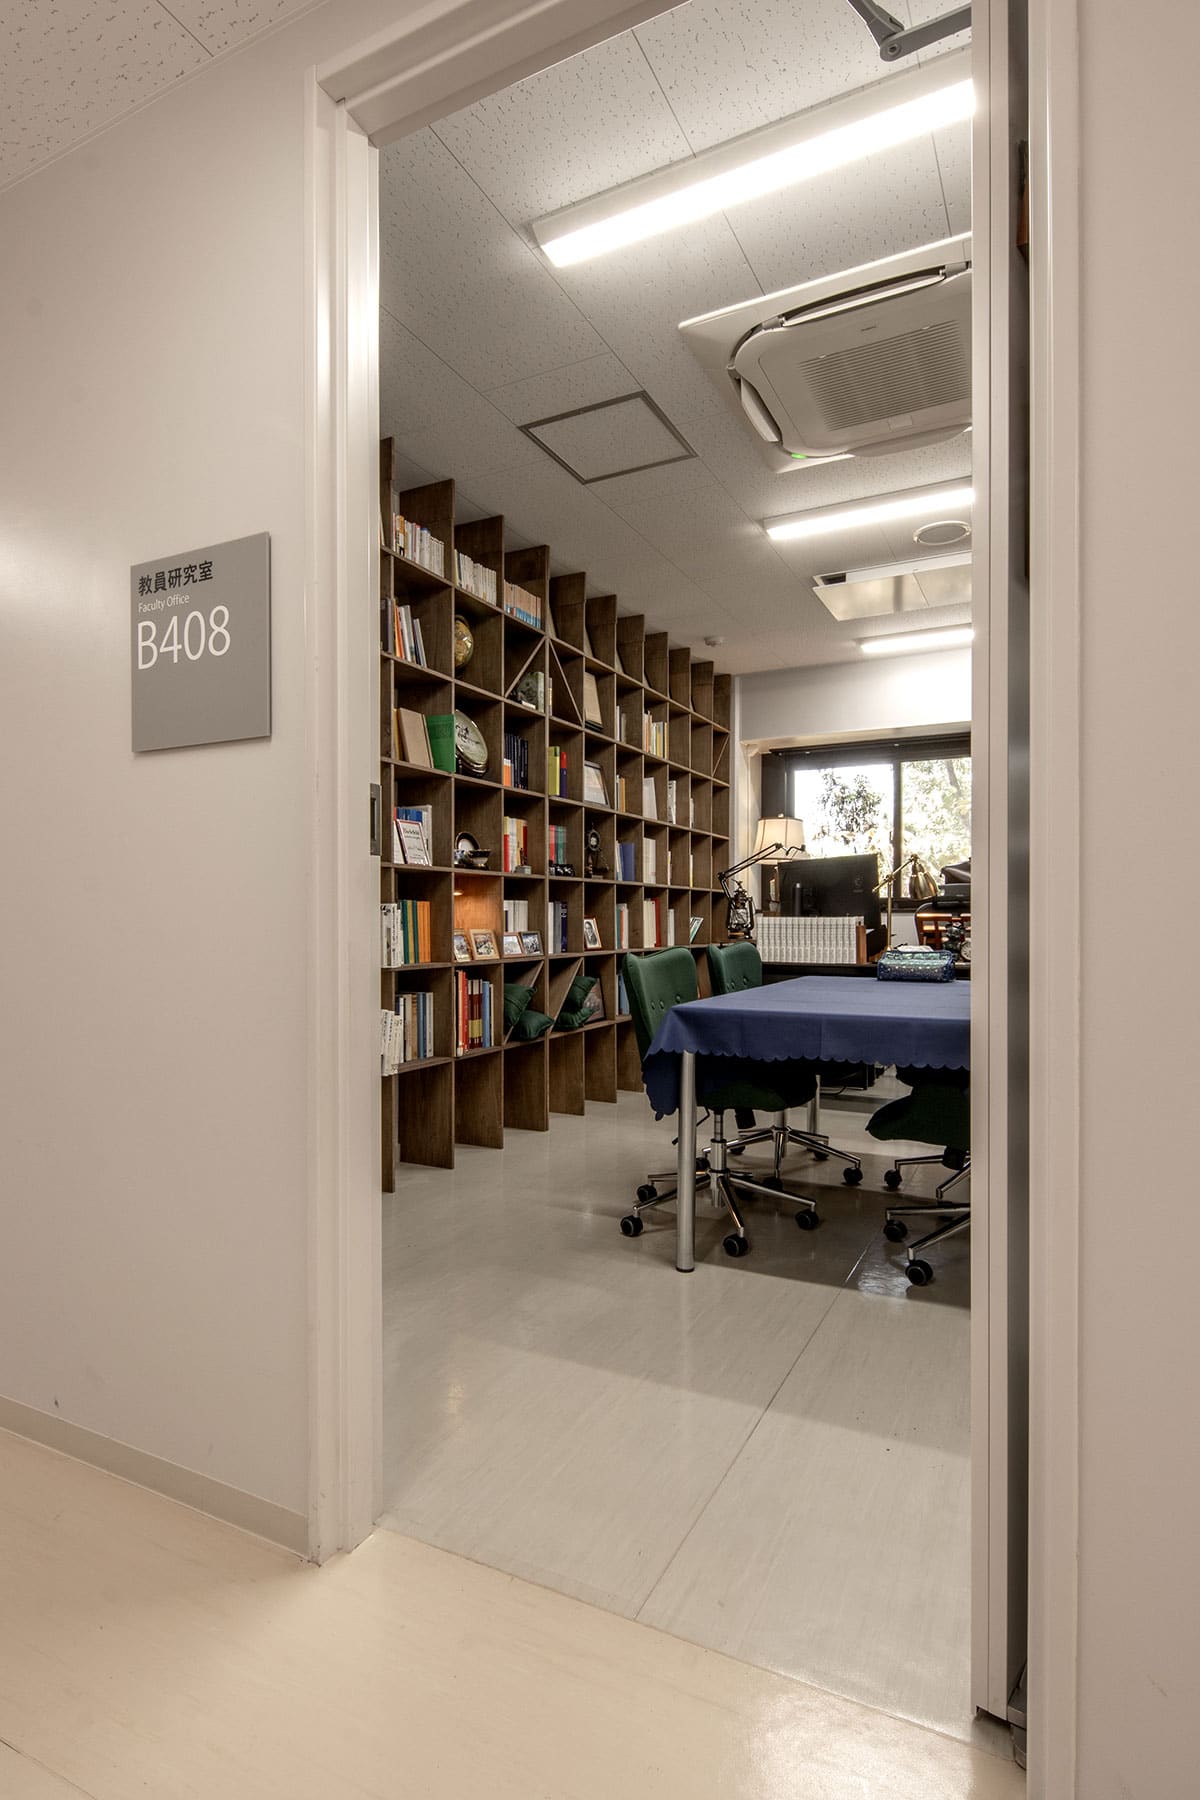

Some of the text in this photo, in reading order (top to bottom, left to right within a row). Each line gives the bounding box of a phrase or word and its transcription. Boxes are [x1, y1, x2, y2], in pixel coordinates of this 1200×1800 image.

[138, 560, 214, 596] 教員研究室
[138, 593, 190, 614] Faculty Office
[137, 605, 231, 669] B408
